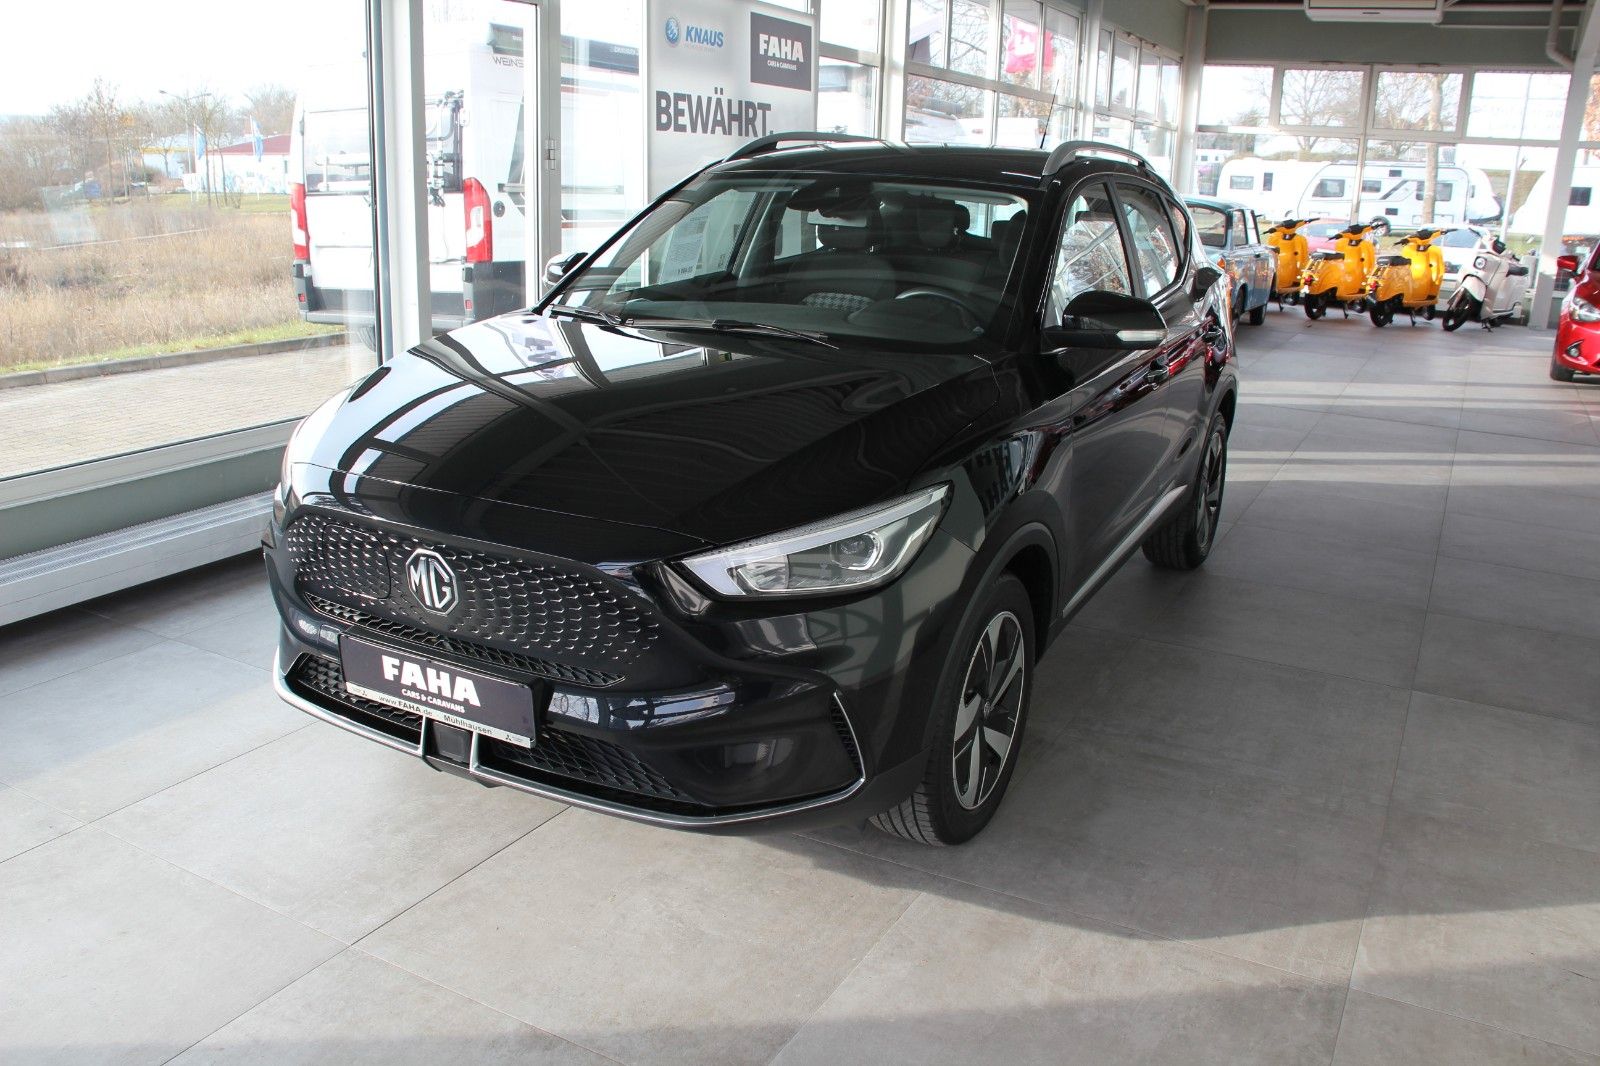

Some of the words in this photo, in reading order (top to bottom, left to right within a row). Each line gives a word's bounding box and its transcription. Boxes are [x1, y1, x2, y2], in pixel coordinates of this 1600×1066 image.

[686, 26, 723, 47] KNAUS
[759, 34, 804, 62] FAHA
[410, 557, 452, 608] MG
[382, 655, 481, 707] FAHA
[379, 695, 433, 717] www.FAHA.de
[401, 689, 420, 700] CARS
[427, 695, 465, 713] CARAVANS
